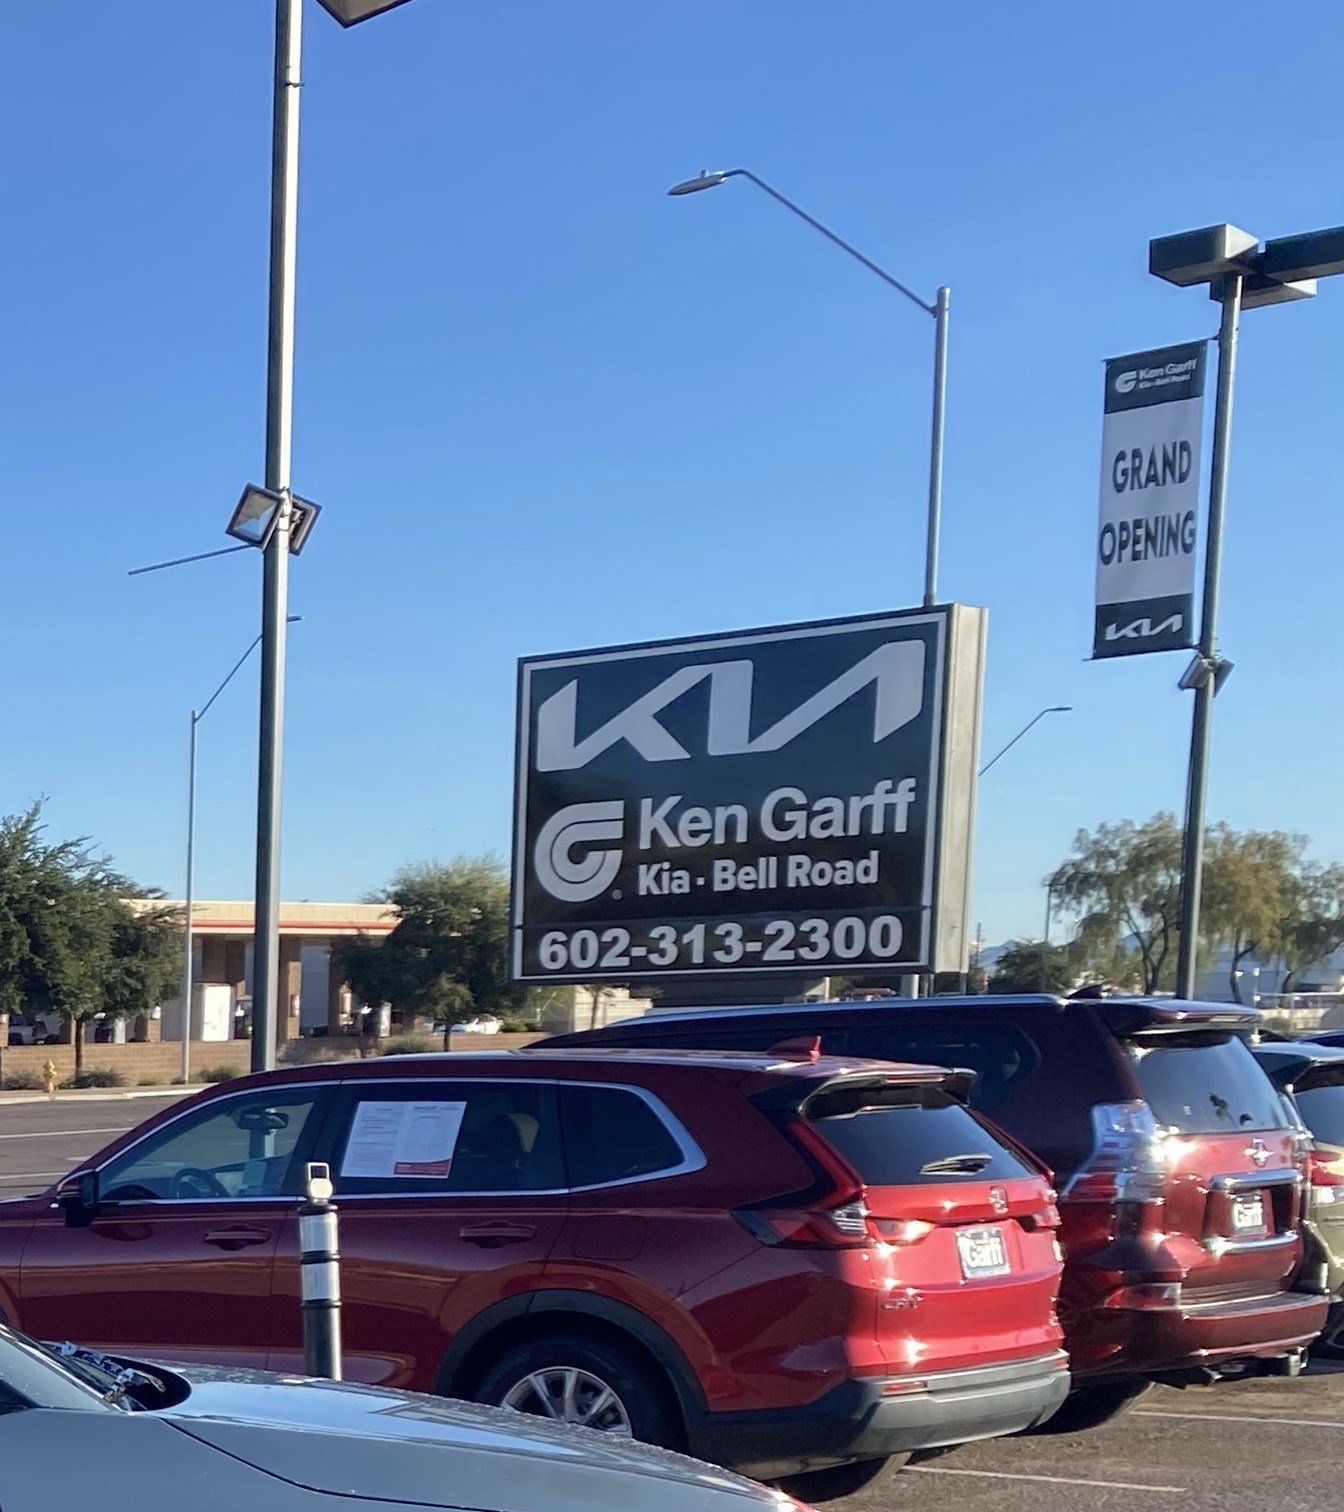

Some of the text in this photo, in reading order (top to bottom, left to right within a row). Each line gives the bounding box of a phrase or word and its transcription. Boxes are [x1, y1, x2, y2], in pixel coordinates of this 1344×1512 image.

[1112, 440, 1192, 494] GRAND
[1098, 509, 1196, 566] OPENING
[537, 639, 926, 772] KIA
[638, 777, 917, 850] Ken Garff
[638, 862, 691, 896] Kia
[712, 857, 777, 892] Bell
[787, 850, 880, 888] Road
[538, 914, 904, 970] 602-313-2300
